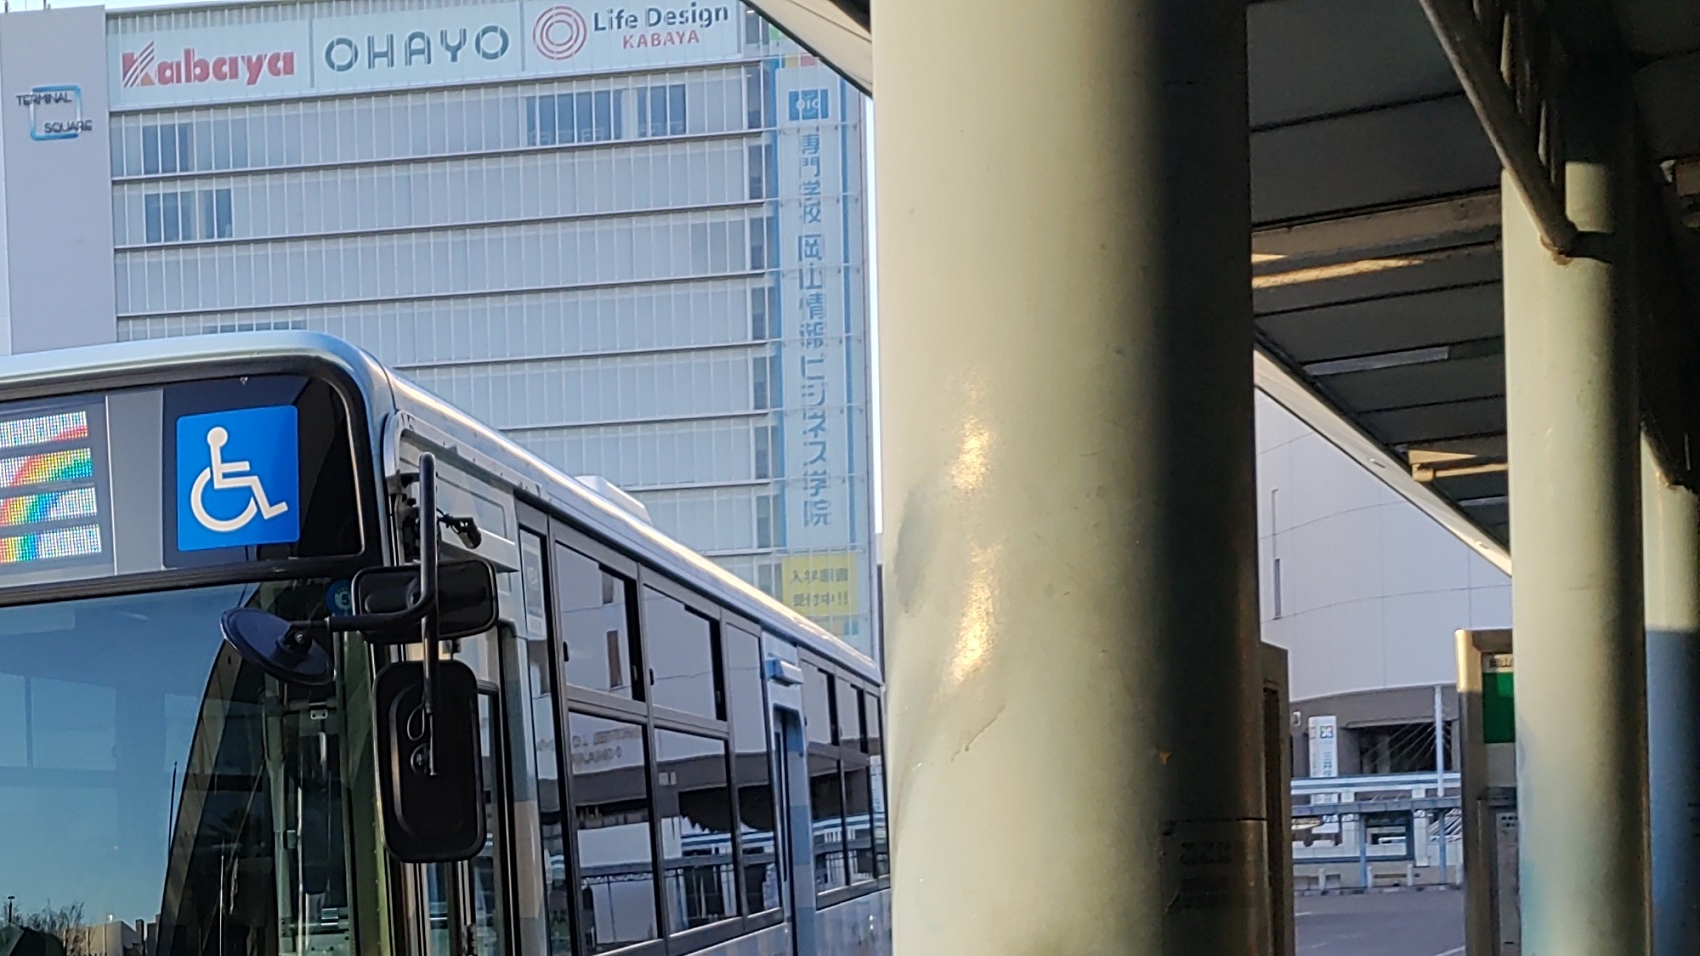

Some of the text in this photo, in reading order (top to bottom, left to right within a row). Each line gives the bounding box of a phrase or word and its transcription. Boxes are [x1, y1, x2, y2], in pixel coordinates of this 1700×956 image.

[594, 2, 728, 31] Life Design
[325, 25, 509, 72] OHAYO
[622, 29, 699, 49] KABAYA
[122, 40, 295, 88] Kabaya
[16, 92, 73, 106] TERMINAL
[44, 120, 92, 133] SQUARE
